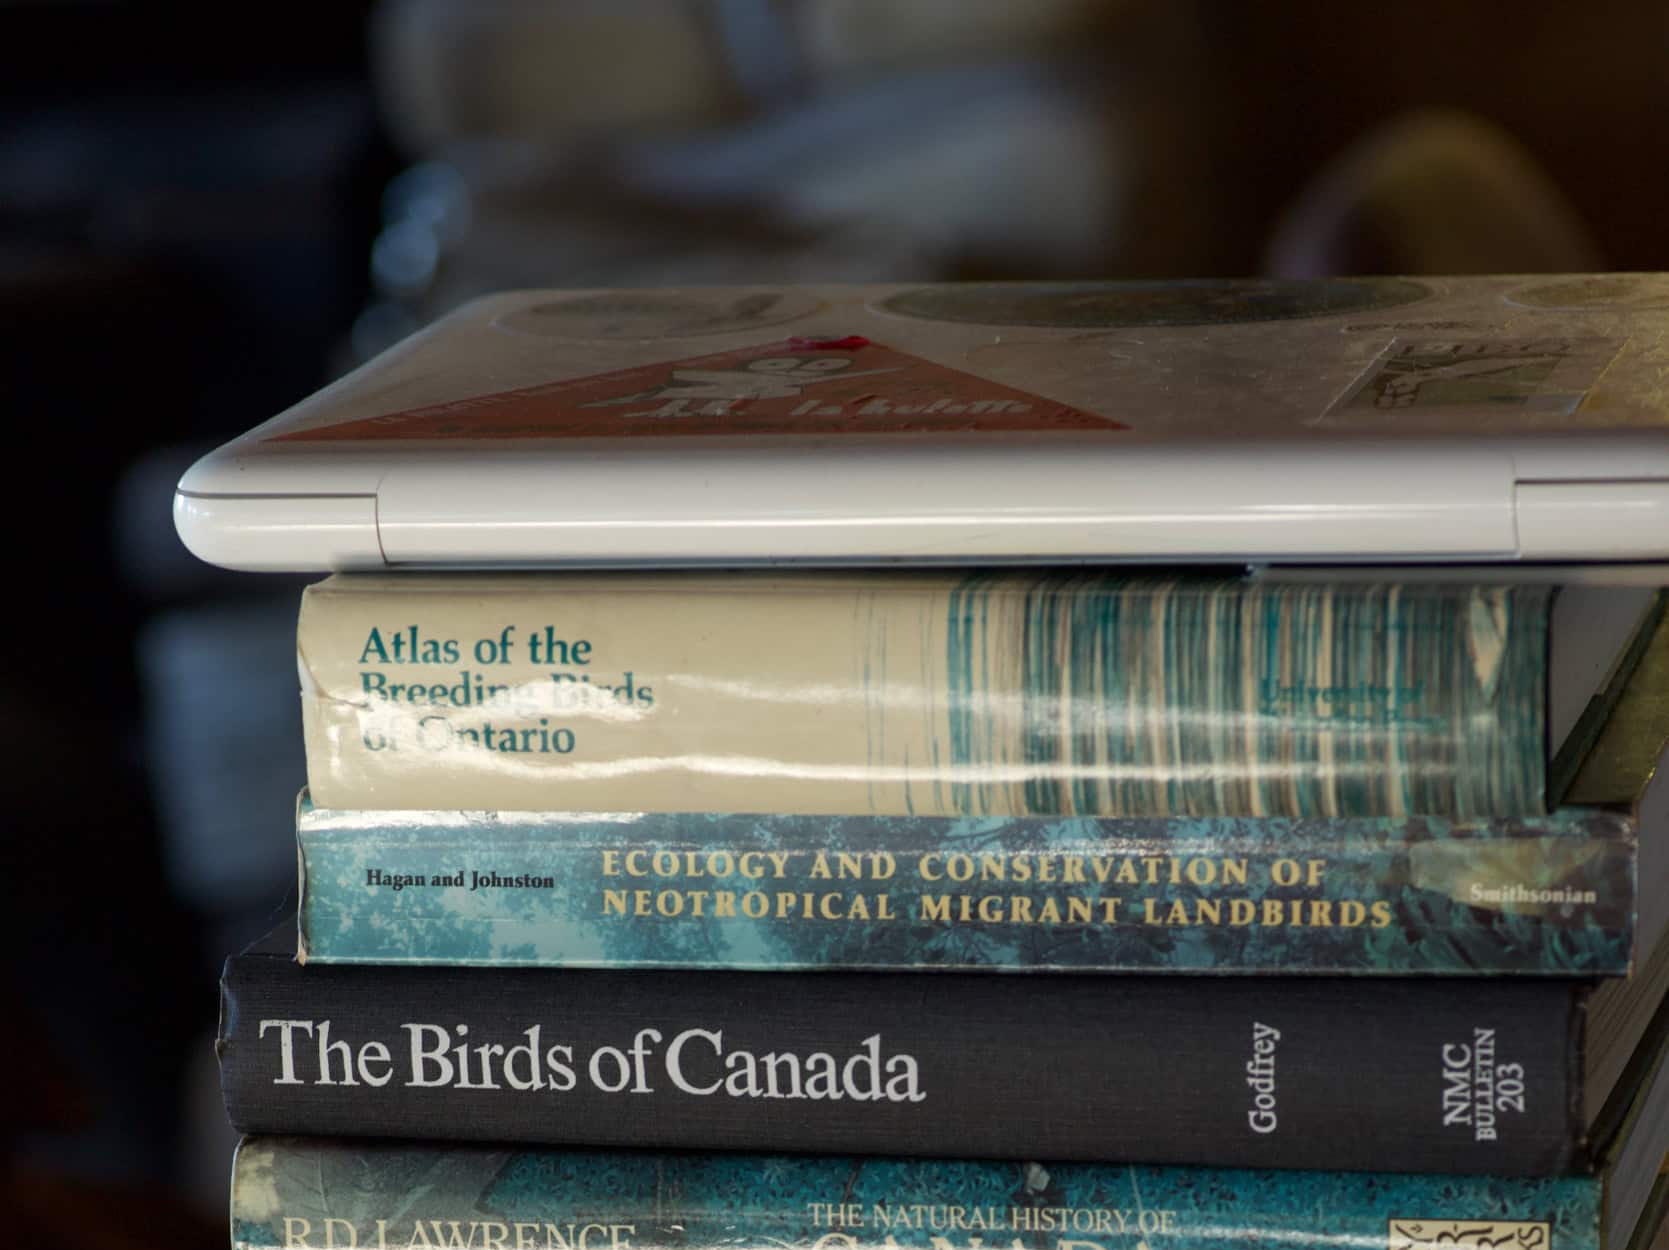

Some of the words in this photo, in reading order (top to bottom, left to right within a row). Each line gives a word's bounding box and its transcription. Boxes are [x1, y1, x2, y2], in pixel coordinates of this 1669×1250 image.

[359, 625, 460, 665] Atlas
[474, 625, 515, 665] of
[528, 625, 592, 665] the
[417, 714, 576, 754] Ontario
[365, 868, 426, 891] Hagan
[431, 869, 465, 888] and
[470, 870, 555, 890] Johnston
[602, 849, 789, 879] ECOLOGY
[808, 850, 896, 881] AND
[919, 851, 1249, 887] CONSERVATION
[1271, 857, 1327, 888] OF
[602, 889, 896, 921] NEOTROPICAL
[919, 893, 1123, 925] MIGRANT
[1143, 897, 1395, 930] LANDBIRDS
[1470, 883, 1598, 906] Smithsonian
[258, 1019, 393, 1088] The
[400, 1023, 577, 1092] Birds
[589, 1029, 662, 1094] of
[665, 1029, 926, 1103] Canada
[1247, 1021, 1282, 1135] Godfrey
[1442, 1042, 1473, 1127] NMC
[1475, 1027, 1497, 1141] BULLETIN
[1496, 1062, 1527, 1113] 203
[808, 1203, 864, 1228] THE
[873, 1204, 1009, 1231] NATURAL
[1012, 1207, 1135, 1233] HISTORY
[1138, 1210, 1177, 1233] OF
